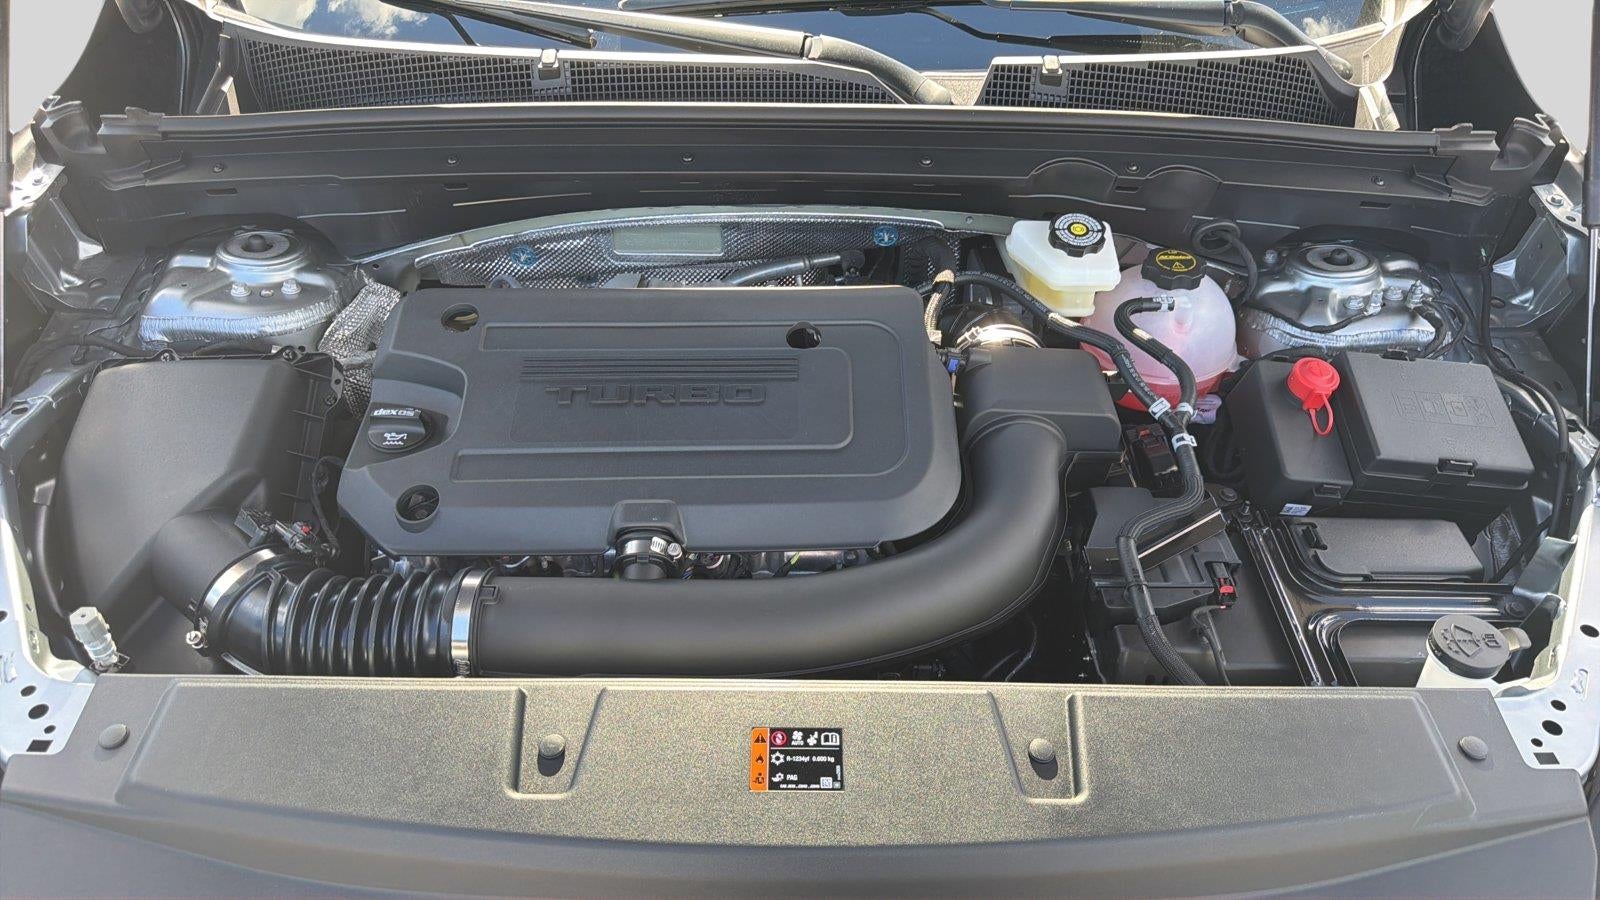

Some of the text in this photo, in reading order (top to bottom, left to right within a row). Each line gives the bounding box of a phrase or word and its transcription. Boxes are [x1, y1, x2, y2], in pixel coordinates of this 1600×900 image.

[545, 384, 767, 405] TURBO
[373, 408, 415, 416] dexos
[786, 755, 810, 763] R-1234yf
[827, 755, 835, 763] kg
